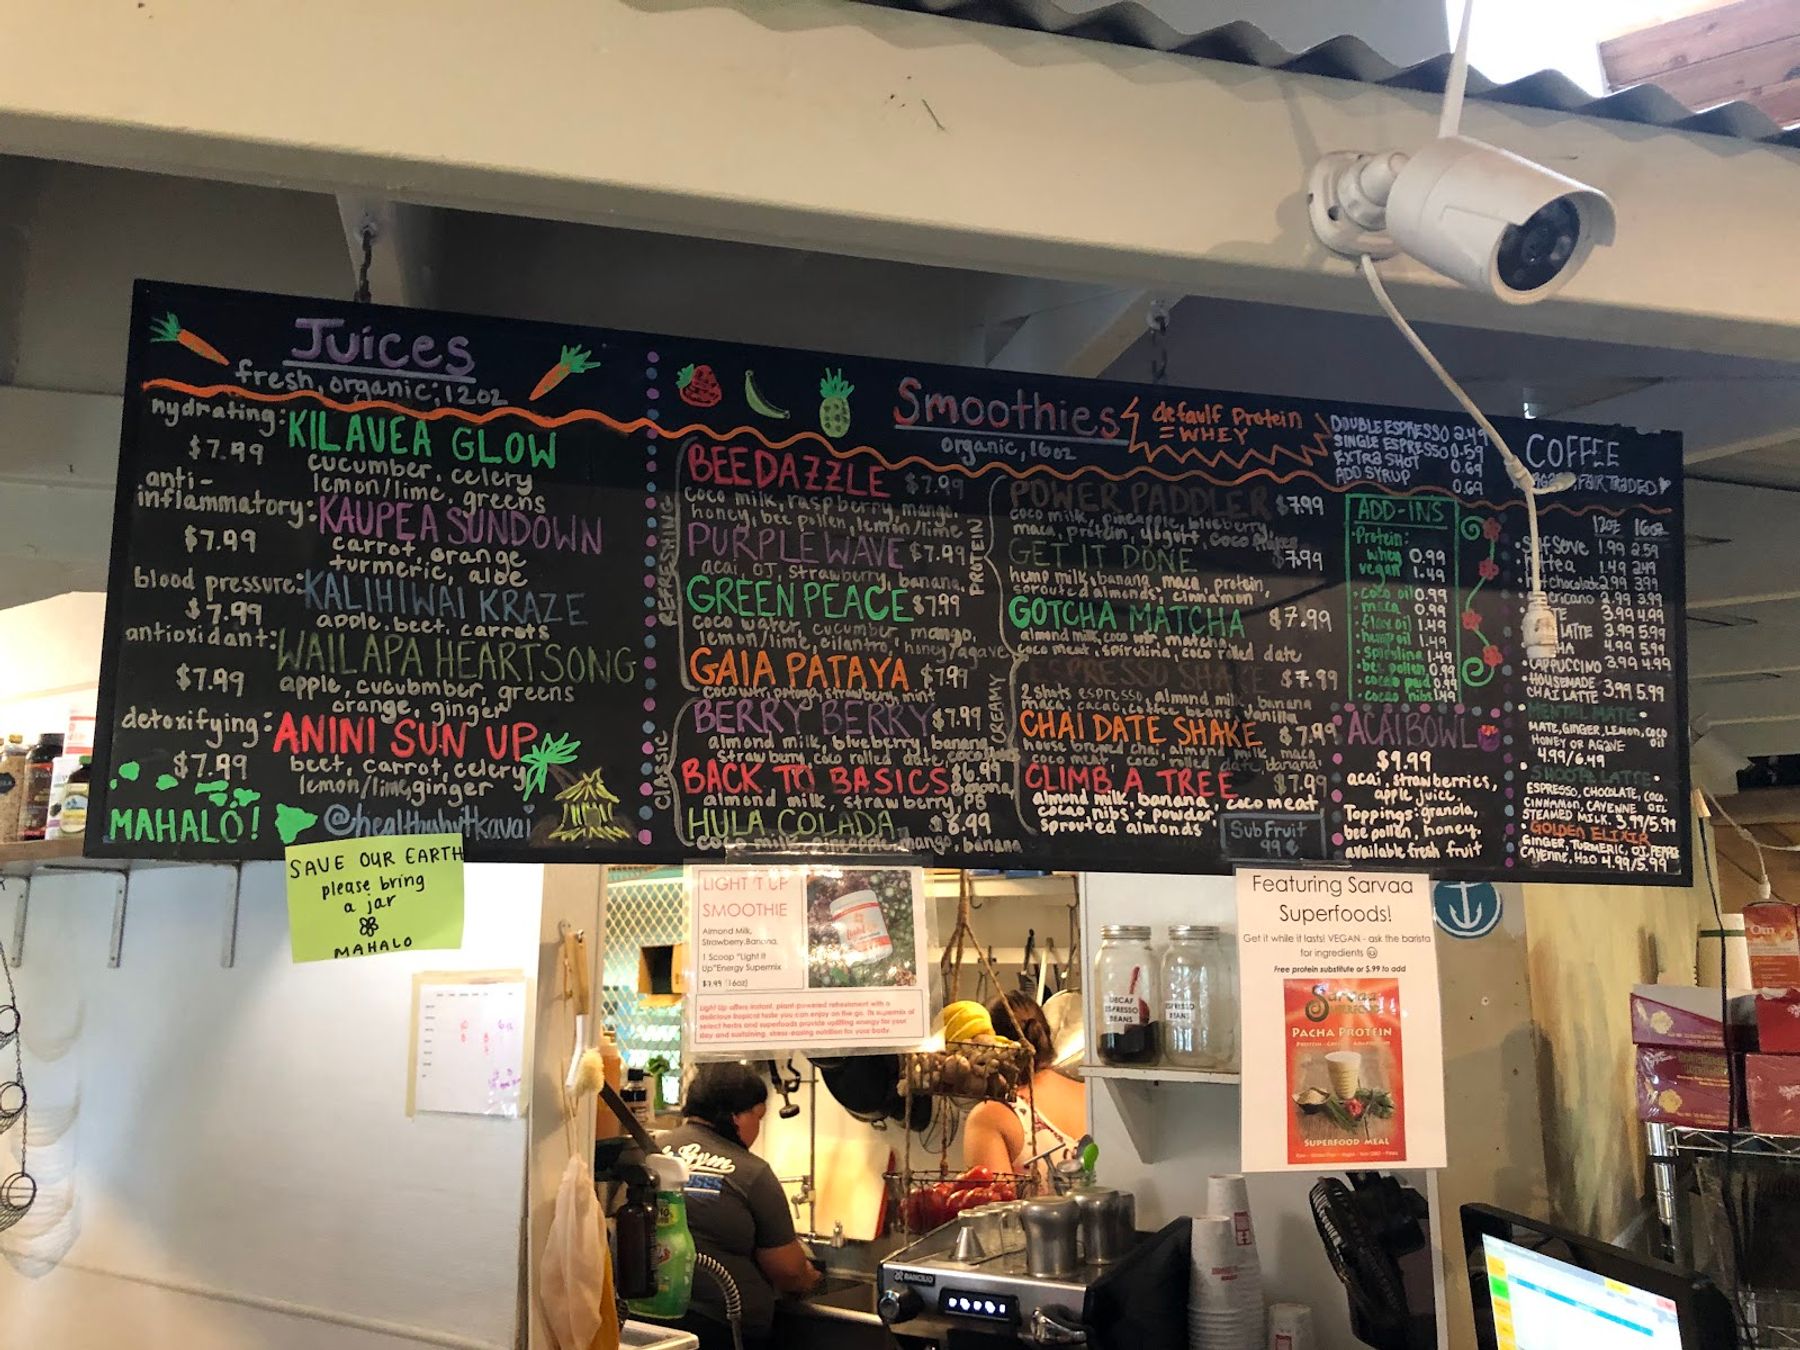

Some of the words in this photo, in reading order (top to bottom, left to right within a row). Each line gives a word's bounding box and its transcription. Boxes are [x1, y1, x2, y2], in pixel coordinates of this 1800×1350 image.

[291, 317, 476, 377] Juices
[893, 376, 1121, 439] Smoothies
[1231, 407, 1303, 429] Protein
[152, 397, 286, 437] hydrating:
[452, 426, 556, 469] GLOW
[1179, 426, 1249, 446] WHEY
[1330, 414, 1382, 435] DOUBLE
[1384, 419, 1449, 443] ESPRESSO
[1453, 425, 1488, 446] 2.49
[188, 434, 264, 465] $7.99
[941, 436, 1026, 466] organic,
[1333, 434, 1379, 449] SINGLE
[1383, 437, 1449, 460] ESPRESSO
[1450, 443, 1484, 464] 0.59
[1525, 433, 1620, 468] COFFEE
[687, 443, 891, 498] BEEDAZZLE
[905, 472, 964, 500] $7.99
[1385, 452, 1420, 470] SHOT
[1450, 460, 1483, 478] 0.69
[451, 467, 533, 495] celery
[1335, 466, 1362, 484] ADD
[1365, 465, 1411, 486] SYRUP
[1452, 478, 1483, 496] 0.69
[463, 490, 546, 517] greens
[684, 486, 725, 503] coco
[1009, 479, 1123, 513] POWER
[1275, 494, 1324, 516] $7.99
[137, 484, 317, 529] inflammatory:
[447, 507, 602, 555] SUNDOWN
[760, 509, 792, 525] bee
[1358, 499, 1445, 523] ADD-INS
[184, 524, 257, 553] $7.99
[687, 522, 820, 564] PURPLE
[823, 530, 905, 570] WAVE
[909, 540, 966, 566] $7.99
[431, 547, 527, 577] orange
[967, 518, 986, 597] PROTEIN
[1008, 537, 1070, 569] GET
[1082, 543, 1107, 570] IT
[1121, 544, 1198, 574] DONE
[1272, 548, 1324, 571] $7.99
[469, 567, 528, 587] aloe
[1413, 565, 1446, 583] 1.49
[134, 566, 195, 590] blood
[205, 572, 307, 601] pressure:
[304, 568, 465, 619] KALIHIWAI
[480, 588, 588, 626] KRAZE
[686, 574, 795, 618] GREEN
[803, 581, 914, 623] PEACE
[912, 592, 960, 618] $7.99
[1172, 590, 1254, 605] cinnamon
[1550, 591, 1596, 606] ericano
[185, 597, 262, 626] $7.99
[1008, 595, 1118, 630] GOTCHA
[1129, 601, 1246, 639] MATCHA
[1269, 605, 1333, 632] $7.99
[460, 623, 550, 641] carrots
[125, 621, 277, 650] antioxidant:
[276, 627, 424, 677] WAILAPA
[435, 637, 637, 684] HEARTSONG
[1529, 658, 1602, 674] CAPPUCCINO
[1604, 655, 1638, 671] 3.99
[1641, 657, 1672, 671] 4.99
[176, 662, 245, 698] $7.99
[689, 646, 776, 689] GAIA
[786, 651, 910, 692] PATAYA
[920, 663, 968, 690] $7.99
[1280, 668, 1339, 691] $7.99
[1529, 672, 1596, 689] HOUSEMADE
[498, 684, 575, 712] greens
[1034, 683, 1072, 699] shots
[1526, 686, 1560, 702] CHAI
[1563, 690, 1599, 705] LATTE
[1603, 678, 1633, 700] 3.99
[1636, 683, 1665, 702] 5.99
[430, 701, 502, 727] ginger
[693, 698, 806, 735] BERRY
[821, 700, 936, 738] BERRY
[932, 705, 982, 732] $7.99
[987, 672, 1007, 744] CREAMY
[1244, 704, 1299, 725] vanilla
[121, 705, 273, 749] detoxifying:
[272, 711, 376, 755] ANINI
[390, 718, 467, 759] SUN
[486, 721, 539, 761] UP
[708, 730, 775, 750] almond
[1019, 709, 1085, 741] CHAI
[1092, 713, 1168, 744] DATE
[1172, 715, 1264, 748] SHAKE
[1279, 722, 1338, 747] $7.99
[1347, 710, 1400, 746] ACAI
[1406, 712, 1478, 749] BOWL
[173, 750, 248, 780] $7.99
[1376, 749, 1432, 772] $9.99
[1537, 747, 1606, 769] 4.99/6.49
[454, 760, 527, 791] celery
[681, 757, 763, 794] BACK
[772, 763, 816, 794] TO
[829, 765, 950, 795] BASICS
[1024, 763, 1113, 794] CLIMB
[1123, 767, 1144, 794] A
[1156, 768, 1239, 799] TREE
[1273, 772, 1328, 798] $7.99
[703, 788, 776, 807] almond
[964, 793, 987, 811] PB
[1032, 788, 1089, 806] almond
[1226, 798, 1264, 811] coco
[1267, 793, 1319, 812] meat
[1374, 788, 1413, 805] apple
[110, 806, 261, 843] MAHALO!
[687, 807, 766, 840] HULA
[777, 808, 896, 840] COLADA
[1040, 815, 1117, 836] sprouted
[1126, 822, 1203, 837] almonds
[1522, 809, 1573, 821] STEAMED
[1230, 820, 1262, 839] Sub
[1265, 819, 1308, 839] Fruit
[1590, 826, 1651, 846] ELIXIR
[289, 855, 345, 879] SAVE
[359, 850, 396, 868] OUR
[405, 845, 465, 864] EARTH
[1345, 842, 1406, 859] available
[1407, 841, 1441, 859] fresh
[1445, 840, 1483, 858] fruit
[321, 879, 371, 900] please
[380, 874, 425, 893] bring
[703, 876, 748, 892] LIGHT
[1252, 875, 1342, 898] Featuring
[1348, 876, 1414, 894] Sarvaa
[366, 893, 397, 915] jar
[702, 903, 788, 918] SMOOTHIE
[1279, 904, 1393, 925] Superfoods!
[702, 927, 734, 936] Almond
[1243, 934, 1261, 943] Get
[1271, 934, 1294, 943] while
[1328, 934, 1361, 943] VEGAN
[1368, 934, 1383, 943] ask
[1384, 934, 1400, 943] the
[1401, 934, 1431, 943] barista
[333, 936, 413, 959] MAHALO
[708, 953, 735, 963] Scoop
[1314, 948, 1364, 960] ingredients
[746, 963, 782, 973] Supermix
[1292, 965, 1318, 975] protein
[1320, 965, 1354, 974] substitute
[1365, 965, 1381, 974] $.99
[1109, 1015, 1133, 1023] BEANS
[1291, 1027, 1336, 1038] PACHA
[1338, 1027, 1393, 1037] PROTEIN
[1303, 1138, 1360, 1148] SUPERFOOD
[1363, 1137, 1390, 1146] MEAL
